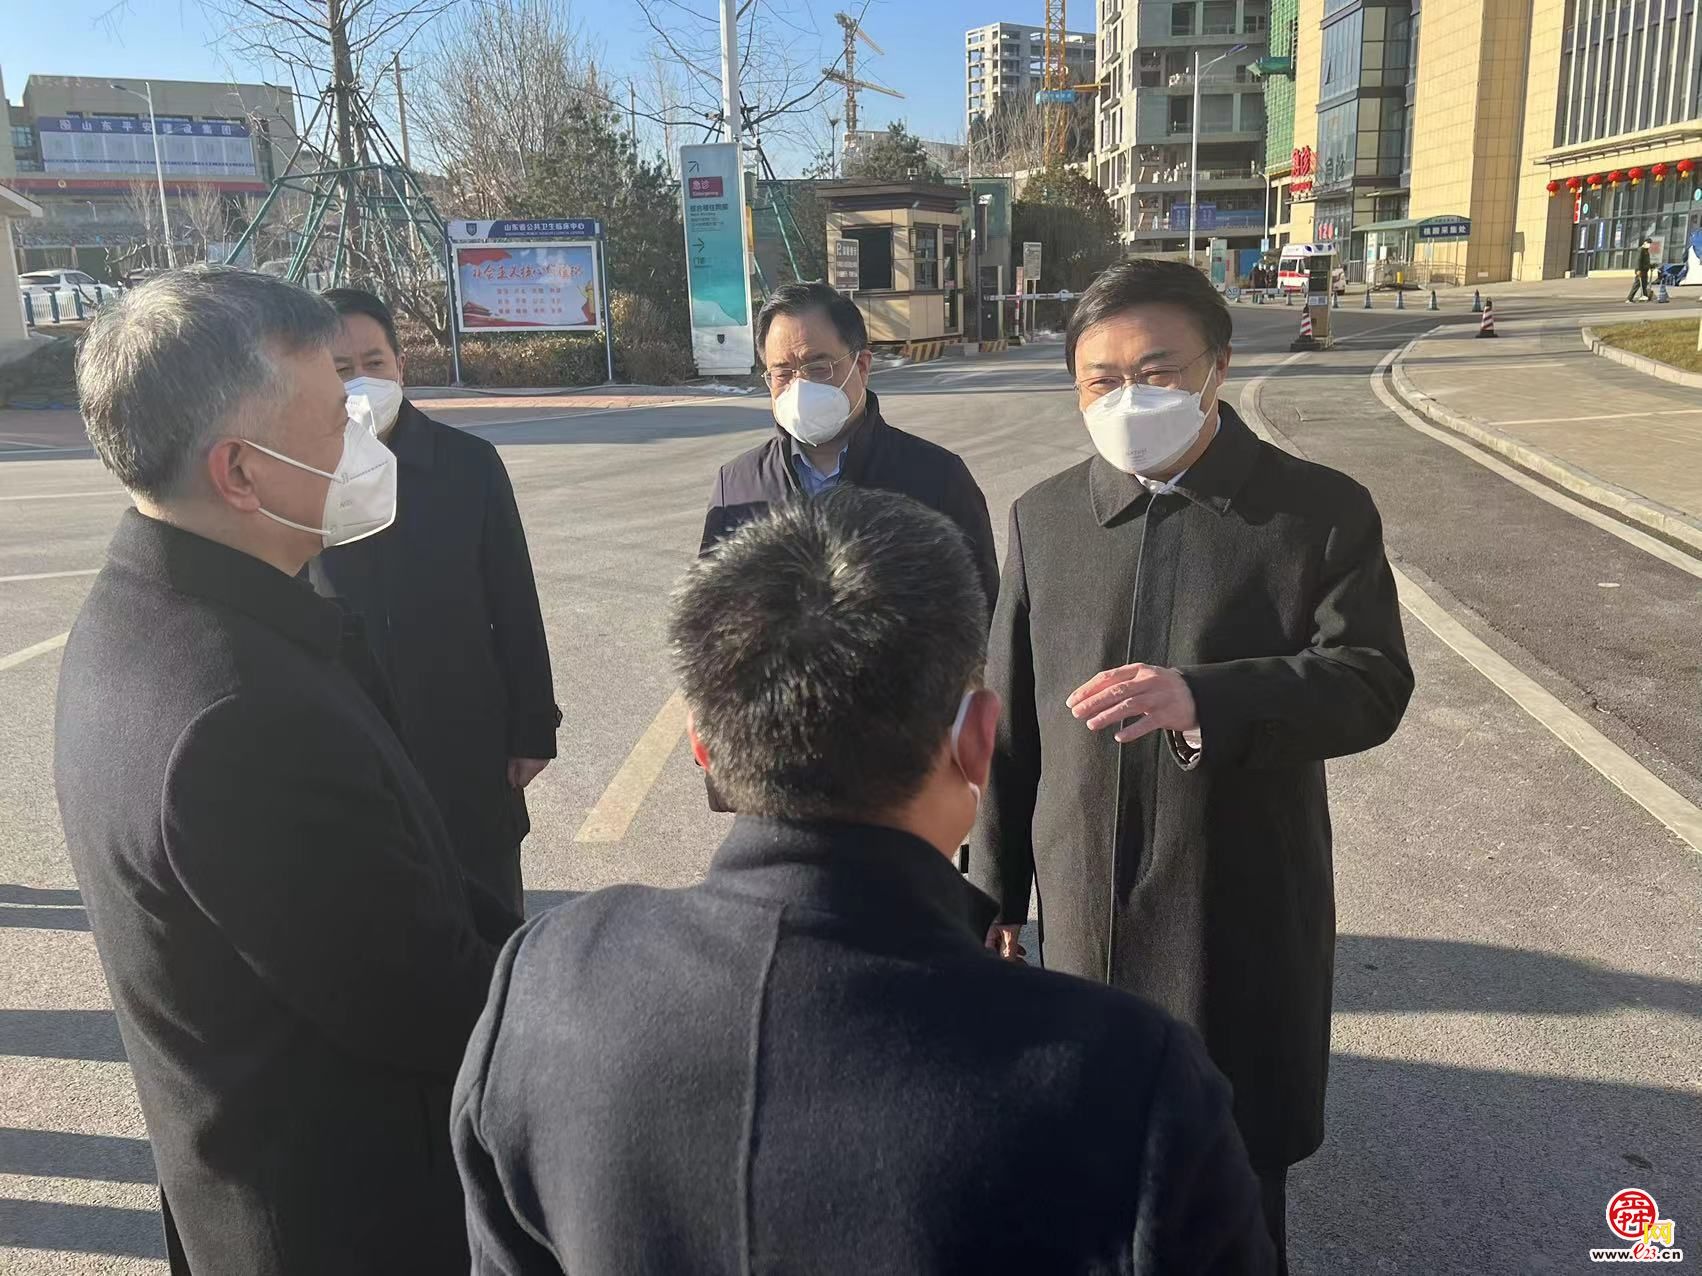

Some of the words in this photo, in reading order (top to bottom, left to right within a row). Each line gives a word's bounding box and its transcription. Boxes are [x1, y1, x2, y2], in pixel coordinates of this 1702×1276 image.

[504, 222, 585, 231] 山东省公共卫生临床中心
[1423, 225, 1467, 236] 核酸采集处
